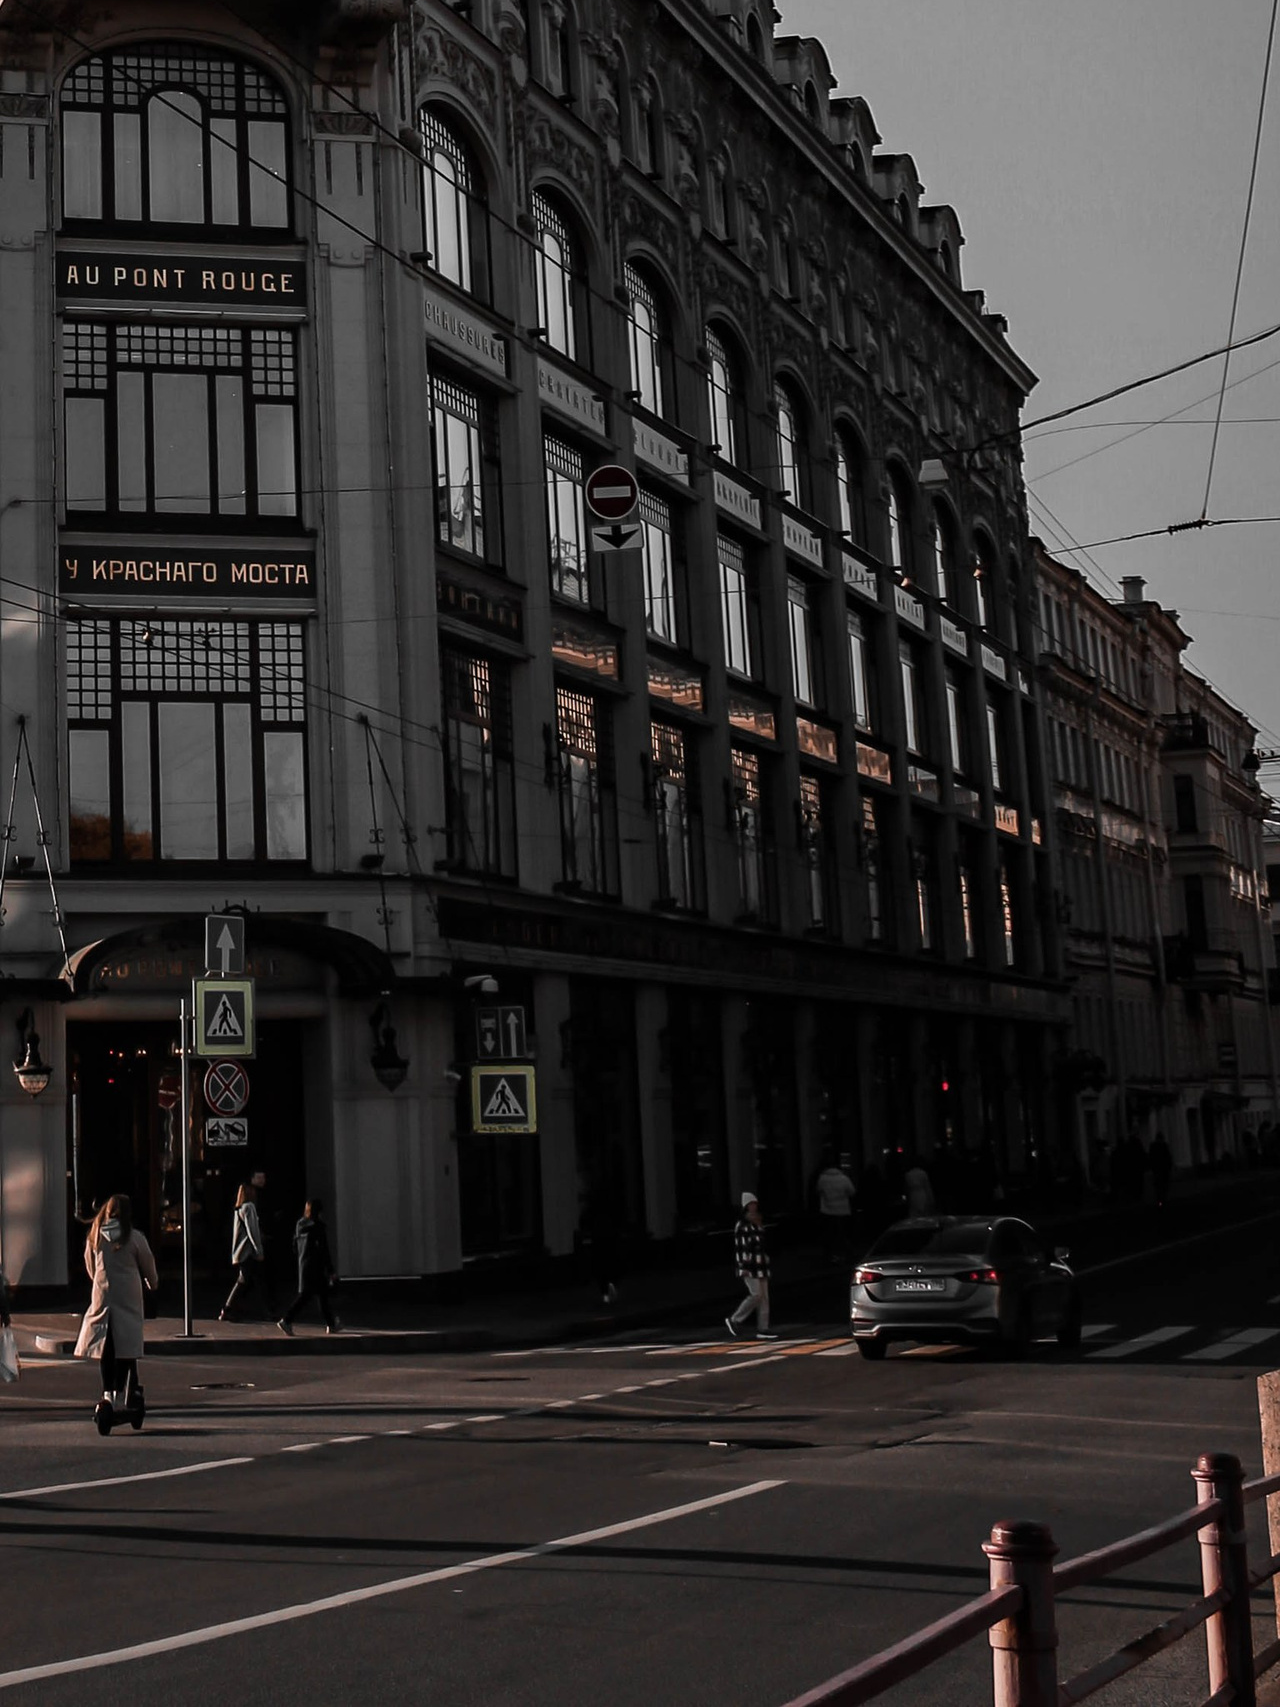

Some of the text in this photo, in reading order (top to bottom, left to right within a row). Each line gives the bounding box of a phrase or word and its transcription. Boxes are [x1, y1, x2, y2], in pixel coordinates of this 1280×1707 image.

[67, 265, 295, 293] AU PONT ROUGE
[424, 299, 505, 365] CHAUSSURES
[65, 559, 309, 585] У КРАСНАГО МОСТА
